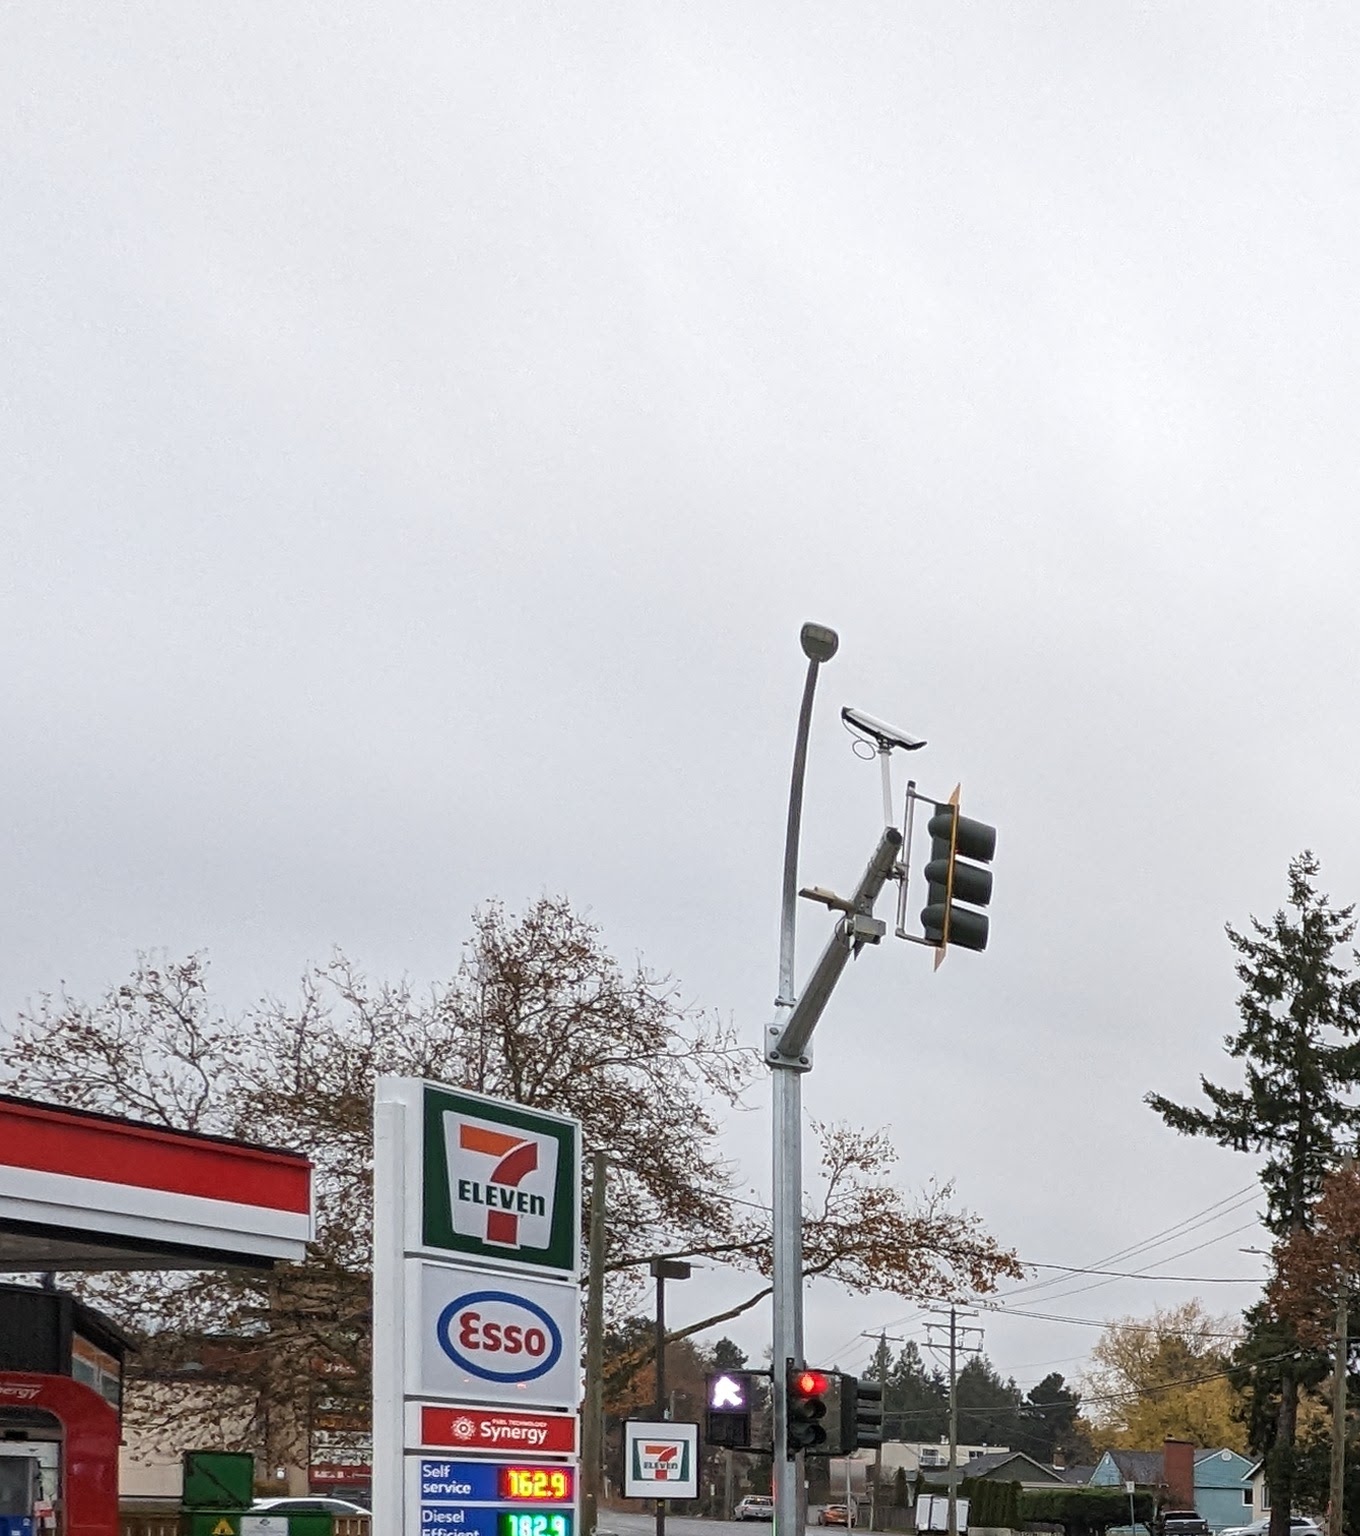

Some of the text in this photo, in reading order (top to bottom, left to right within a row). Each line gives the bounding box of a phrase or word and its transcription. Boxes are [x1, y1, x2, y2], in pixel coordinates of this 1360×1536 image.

[460, 1123, 538, 1245] 7
[459, 1311, 546, 1357] Esso
[480, 1421, 548, 1445] Synergy
[422, 1464, 451, 1478] Self
[645, 1445, 678, 1480] 7
[422, 1480, 471, 1495] service
[508, 1470, 566, 1498] 162.9
[422, 1510, 465, 1523] Diesel
